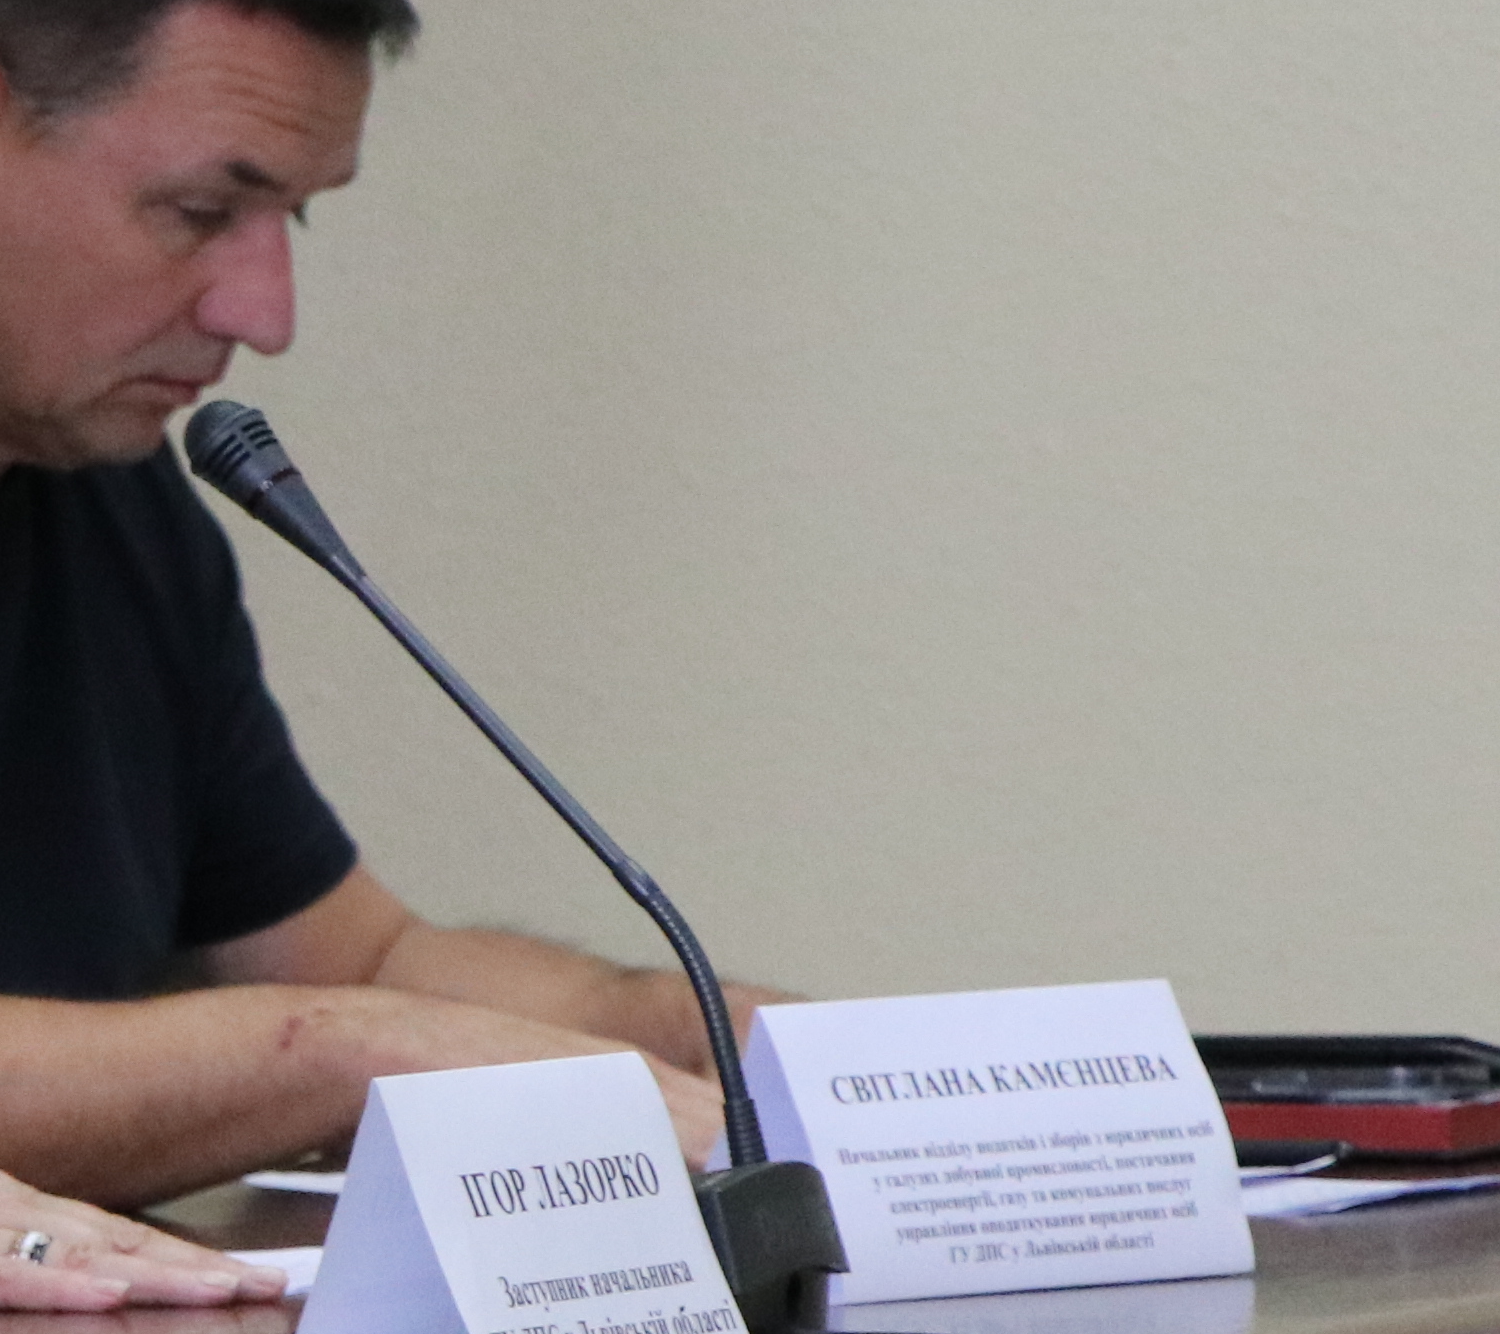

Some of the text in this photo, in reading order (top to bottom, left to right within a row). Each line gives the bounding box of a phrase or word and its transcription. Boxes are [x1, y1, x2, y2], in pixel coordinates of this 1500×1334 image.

[830, 1053, 1178, 1105] СВІТЛАНА КАМЄНЦЕВА
[460, 1152, 660, 1218] ІГОР ЛАЗОРКО
[498, 1260, 694, 1313] Заступник начальника
